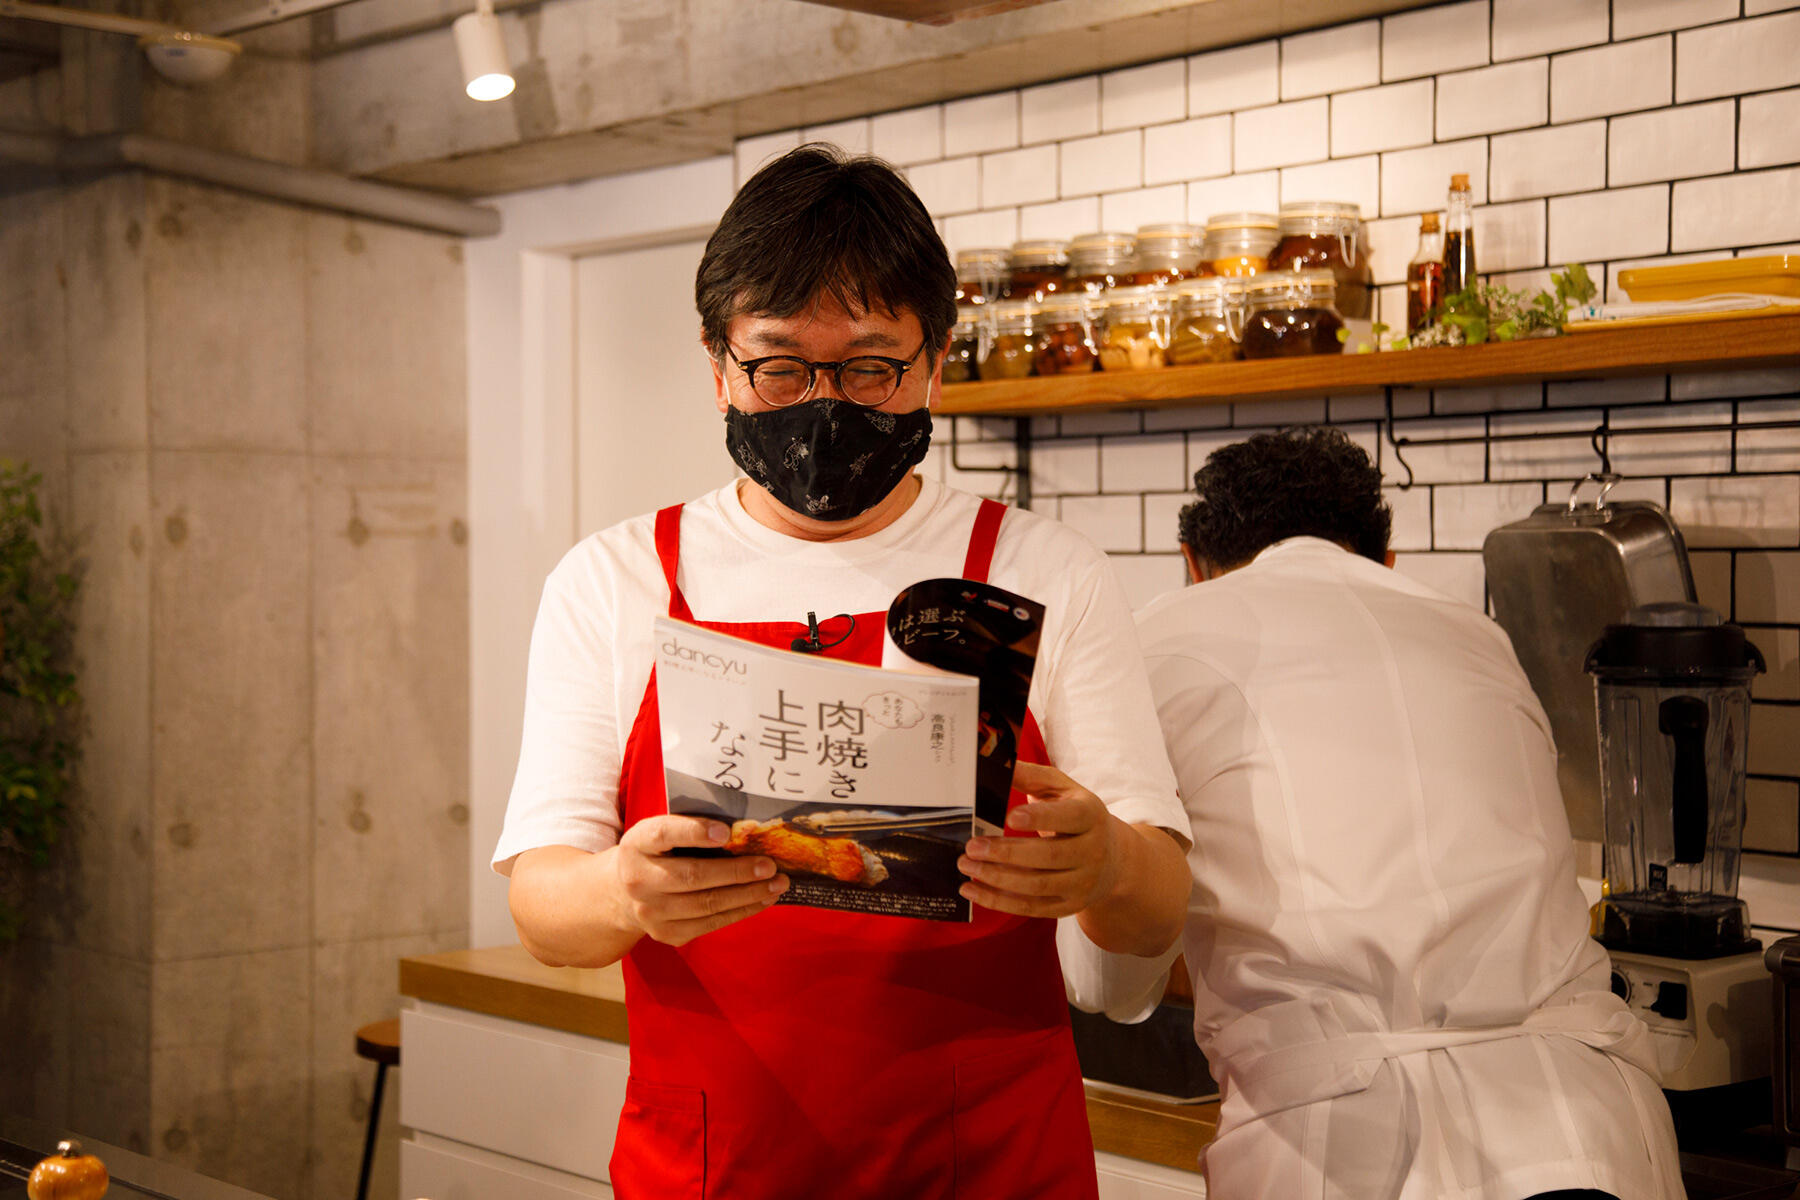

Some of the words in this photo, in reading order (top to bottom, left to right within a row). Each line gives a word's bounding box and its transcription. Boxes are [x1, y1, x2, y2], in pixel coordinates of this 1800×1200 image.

[891, 607, 967, 637] は選ぶ
[897, 627, 967, 646] ビーフ。
[662, 637, 748, 676] dancyu
[710, 720, 746, 792] なる
[758, 688, 809, 794] 上手に
[816, 699, 869, 800] 肉焼き
